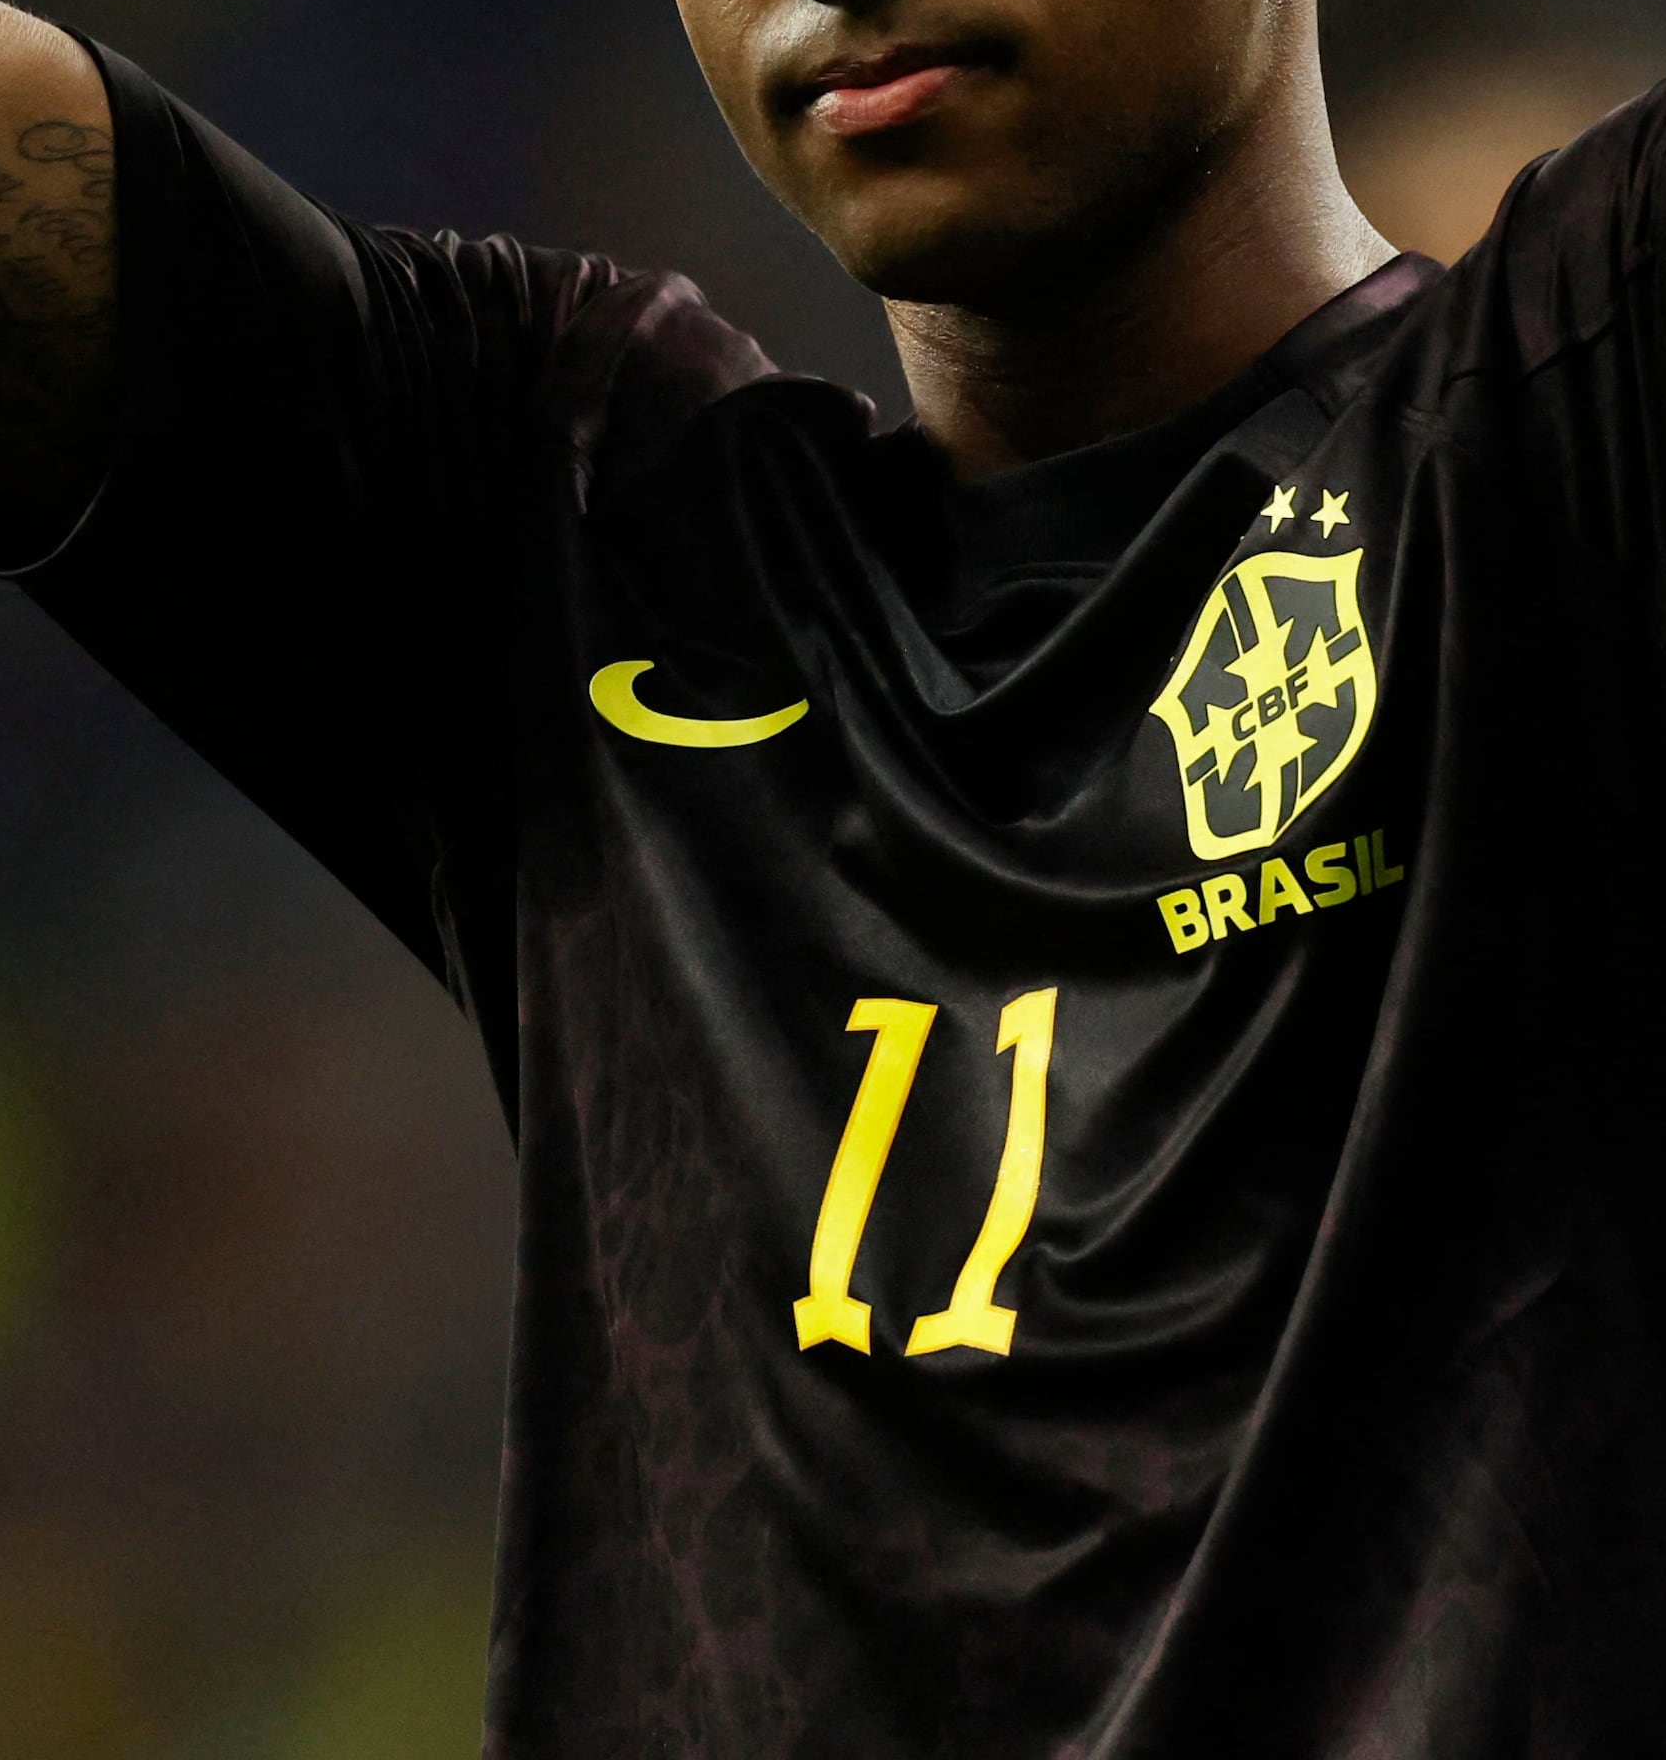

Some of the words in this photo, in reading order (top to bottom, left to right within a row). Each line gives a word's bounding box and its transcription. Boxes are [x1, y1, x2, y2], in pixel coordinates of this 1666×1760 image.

[1231, 666, 1309, 743] CBF
[1156, 829, 1405, 955] BRASIL
[793, 987, 1059, 1357] 11
